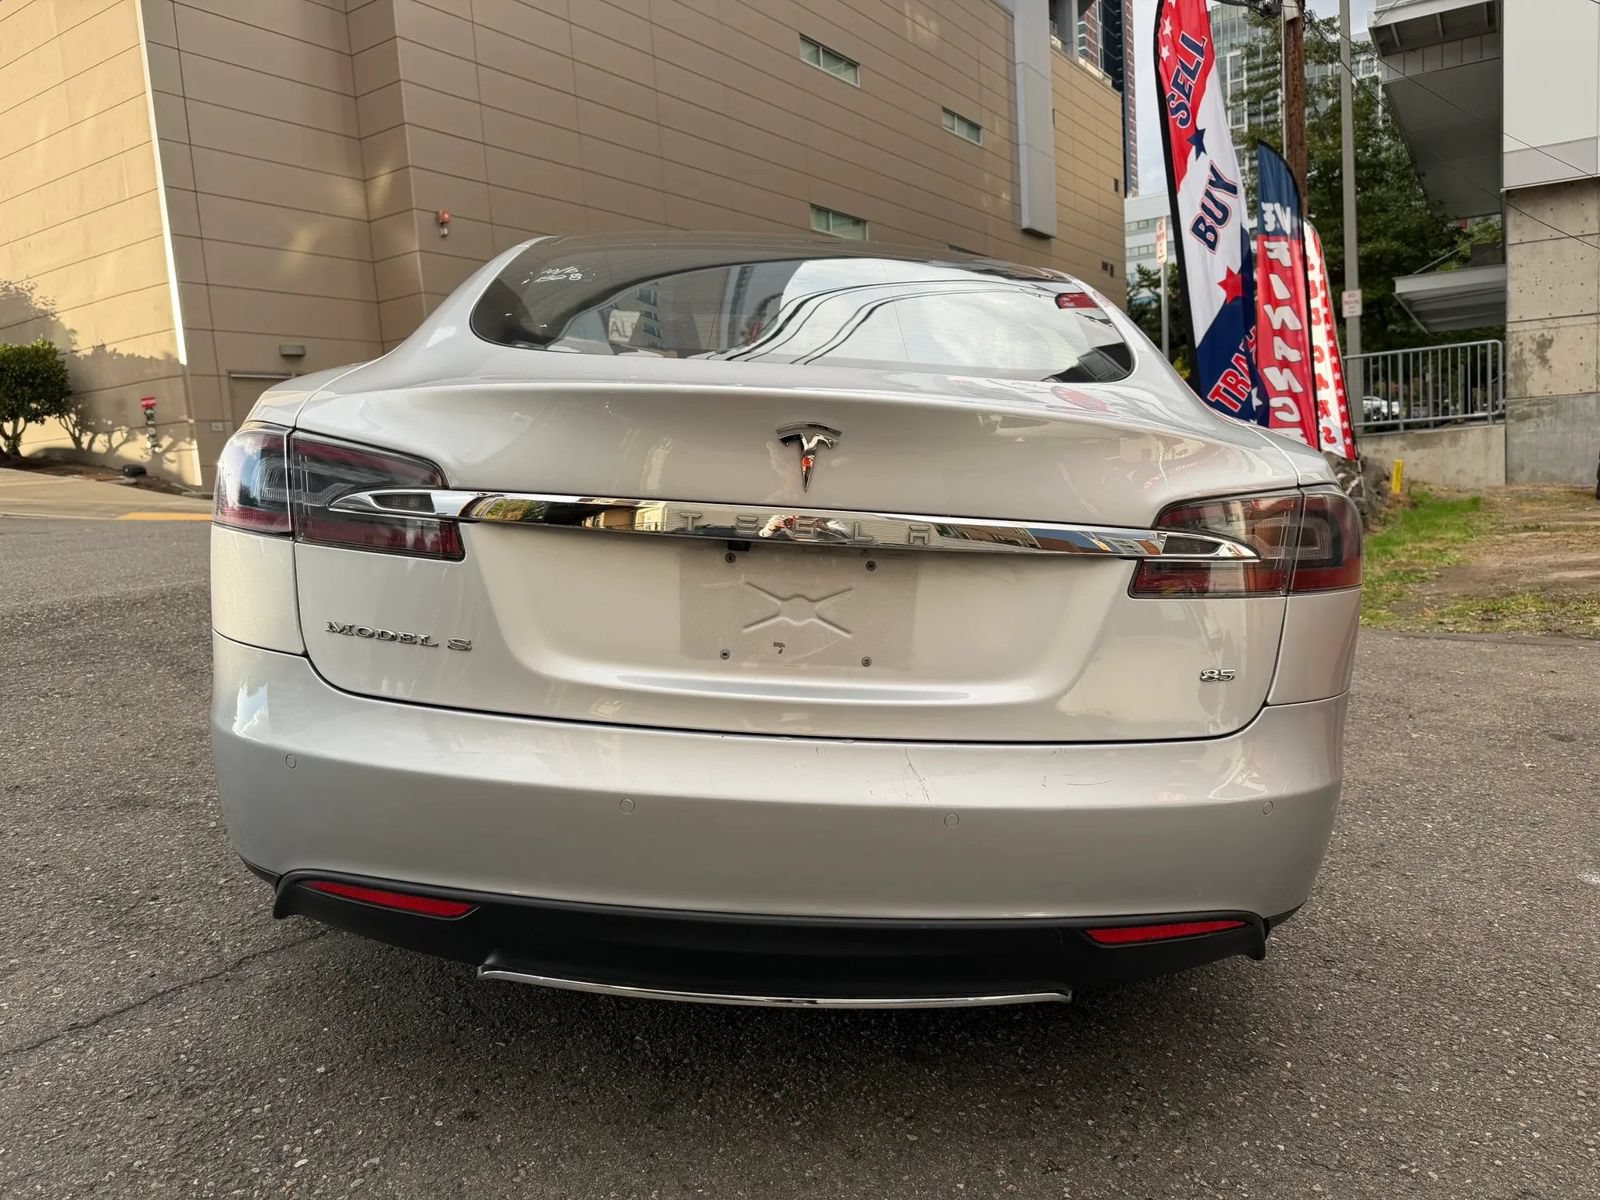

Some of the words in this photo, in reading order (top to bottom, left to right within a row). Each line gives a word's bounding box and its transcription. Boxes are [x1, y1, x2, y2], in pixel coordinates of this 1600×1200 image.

[1166, 31, 1207, 128] SELL
[1188, 160, 1239, 254] BUY
[679, 511, 931, 545] TESLA
[325, 620, 439, 647] MODEL
[447, 637, 473, 651] S
[1200, 669, 1236, 682] 85
